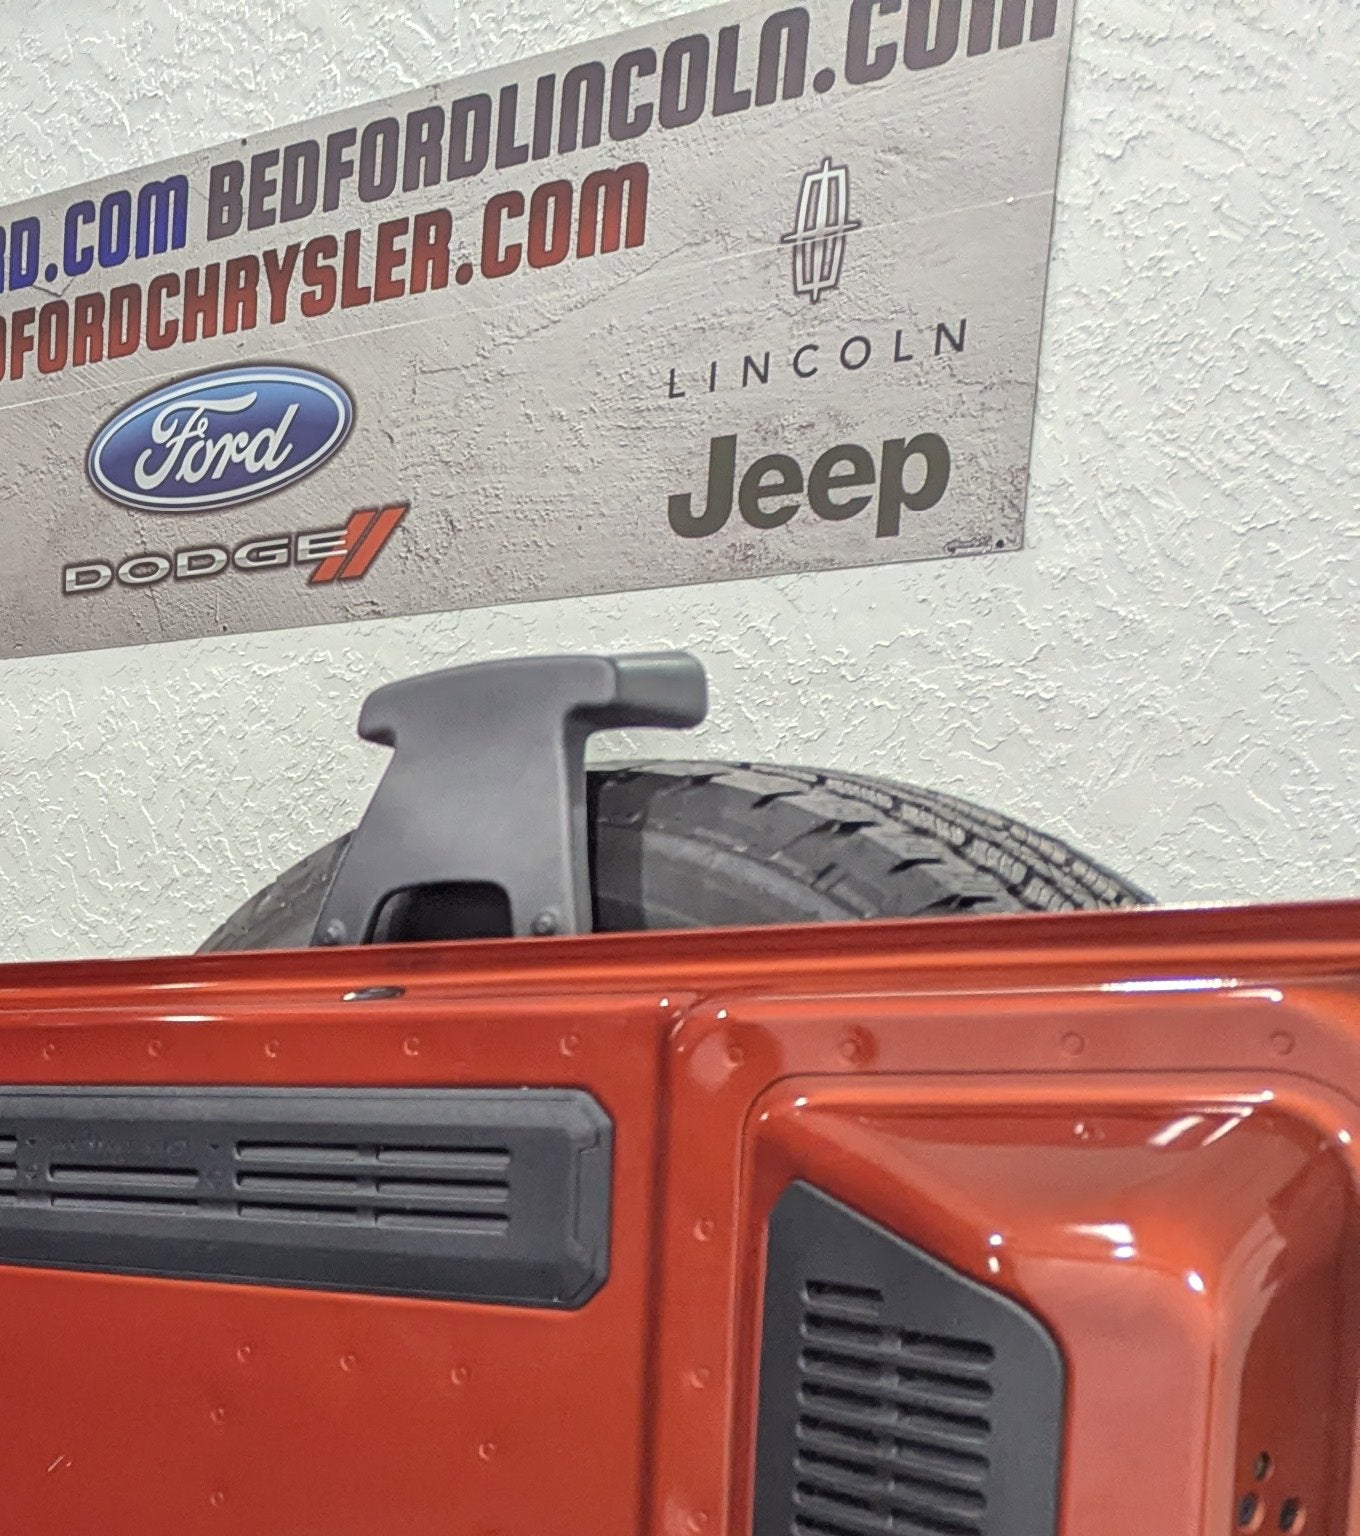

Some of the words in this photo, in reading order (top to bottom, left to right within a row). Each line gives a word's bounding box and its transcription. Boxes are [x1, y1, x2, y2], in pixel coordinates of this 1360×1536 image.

[667, 319, 969, 399] LINCOLN
[134, 391, 299, 490] Ford
[667, 431, 951, 539] Jeep
[62, 529, 350, 596] DODGE
